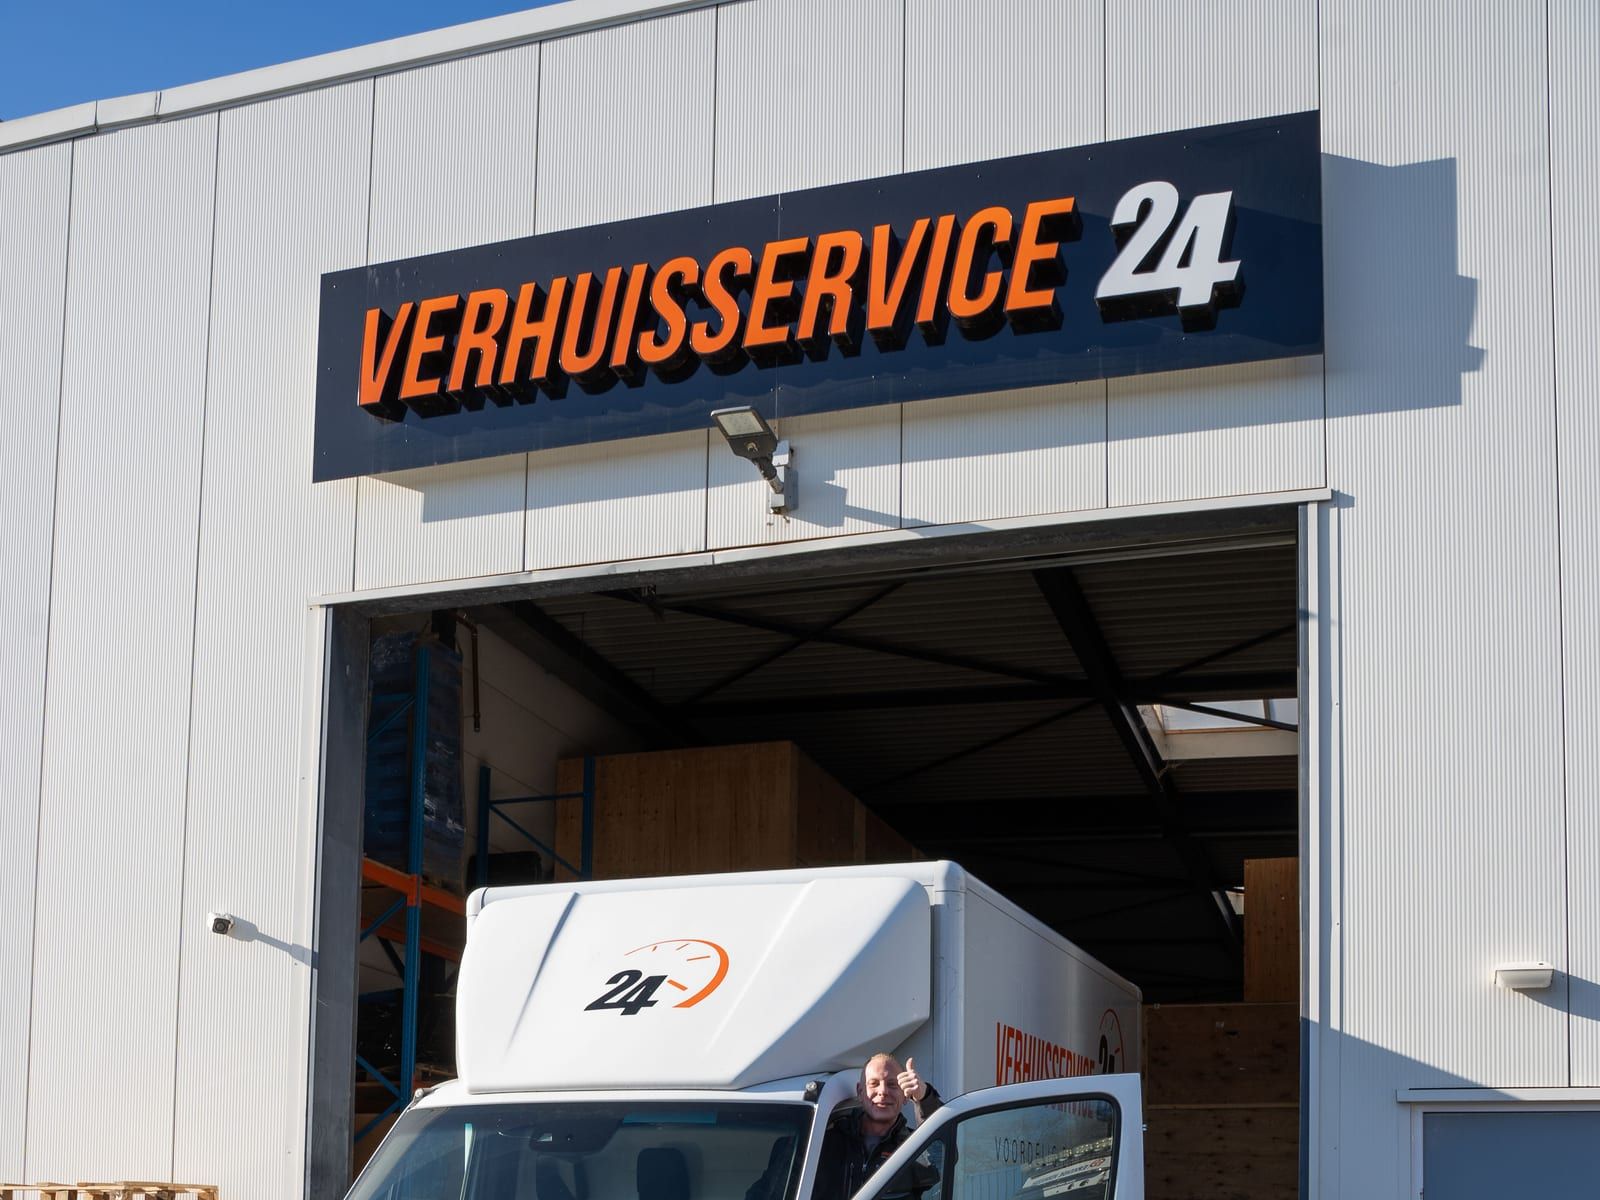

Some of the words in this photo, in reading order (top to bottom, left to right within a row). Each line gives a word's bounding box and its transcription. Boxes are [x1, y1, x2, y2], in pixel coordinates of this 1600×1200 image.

[357, 196, 1076, 407] VERHUISSERVICE
[1094, 179, 1241, 307] 24
[583, 969, 668, 1016] 24
